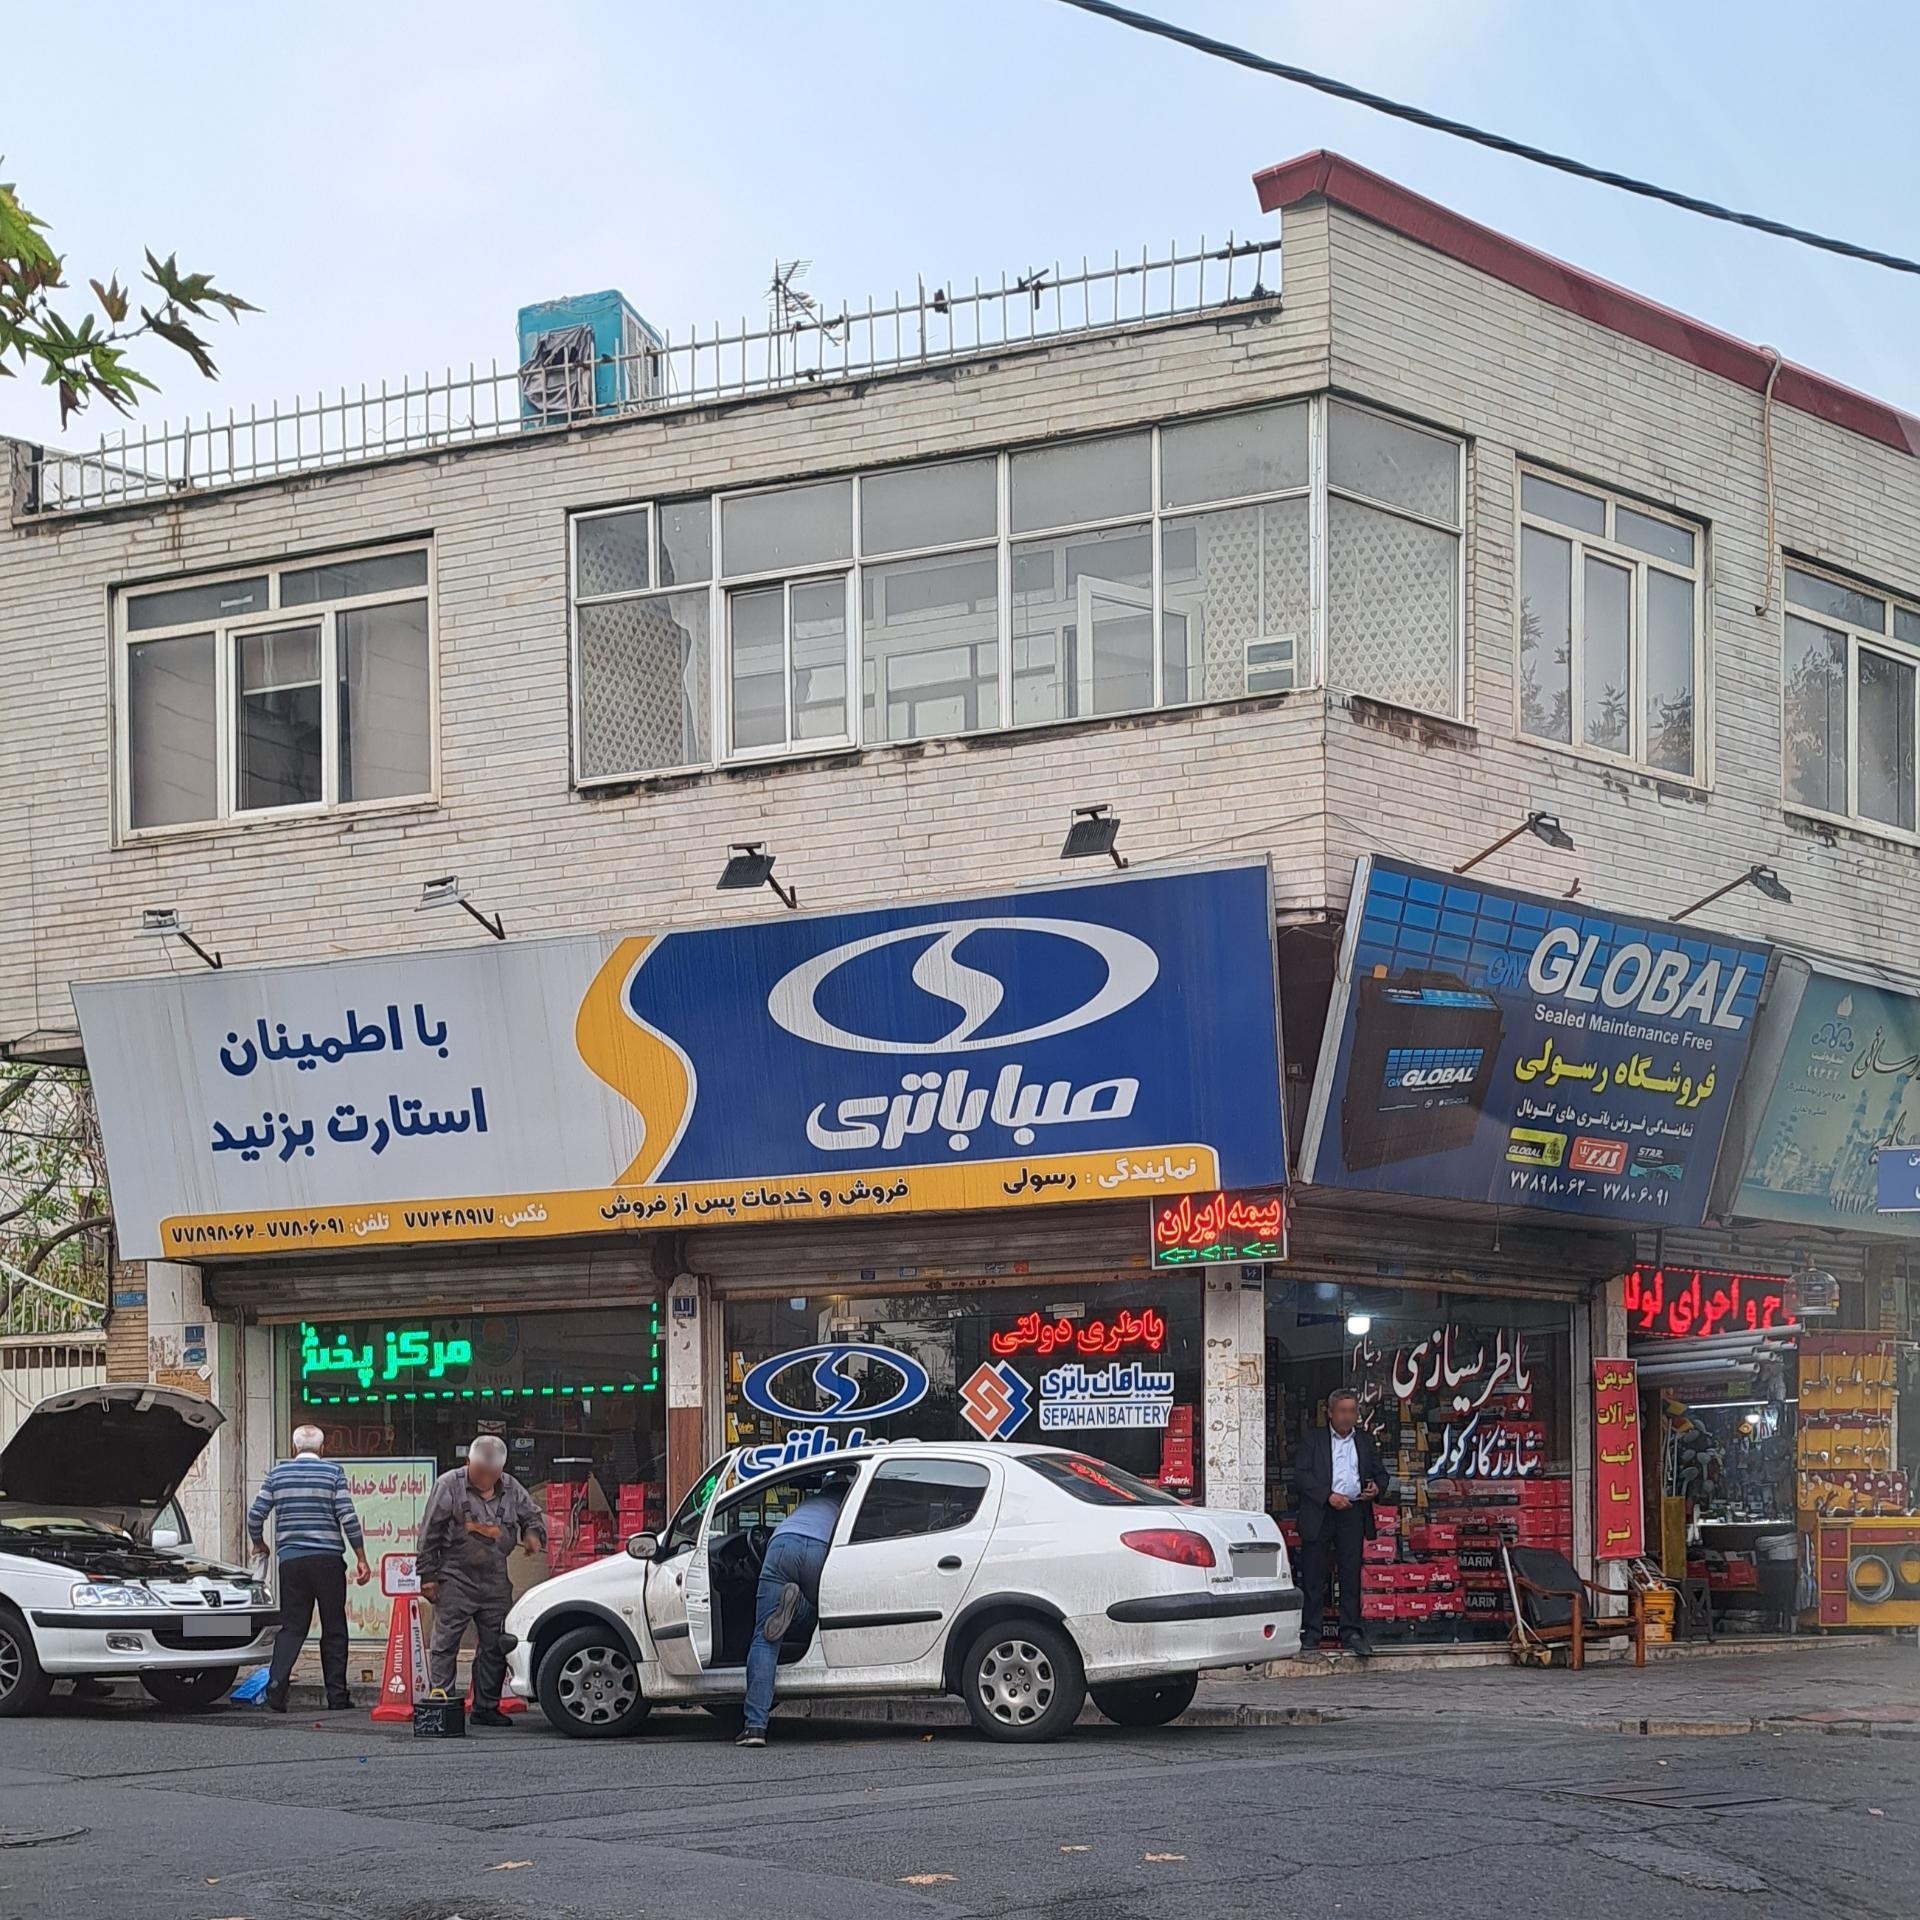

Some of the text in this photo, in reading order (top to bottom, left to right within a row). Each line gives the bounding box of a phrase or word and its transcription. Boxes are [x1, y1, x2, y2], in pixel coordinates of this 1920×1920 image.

[1528, 927, 1747, 1030] GLOBAL
[220, 1003, 449, 1077] با اطمینان
[1534, 1003, 1713, 1051] Sealed Maintenance Free
[1402, 1067, 1474, 1088] GLOBAL
[1515, 1037, 1716, 1108] فروشگاه رسولی
[212, 1086, 488, 1163] استارت بزنید
[806, 1064, 1140, 1151] صبا باتری
[1556, 1105, 1576, 1123] های
[1611, 1113, 1647, 1133] فروش
[1645, 1117, 1694, 1139] نمایندگی
[1508, 1144, 1542, 1158] GLOBAL
[1003, 1168, 1077, 1194] رسولی
[1099, 1157, 1197, 1188] نمایندگی
[601, 1178, 909, 1221] فروش و خدمات پس از فروش
[404, 1207, 495, 1229] ۷۷۲۴۸۹۱۷
[1157, 1192, 1281, 1245] بیمه ایران
[991, 1309, 1165, 1353] باطری دولتی
[383, 1331, 472, 1379] مرکز
[1041, 1362, 1172, 1400] سپاهان باتری
[1043, 1403, 1171, 1427] SEPAHAN BATTERY
[379, 1473, 399, 1500] کلیه
[400, 1473, 427, 1501] انجام
